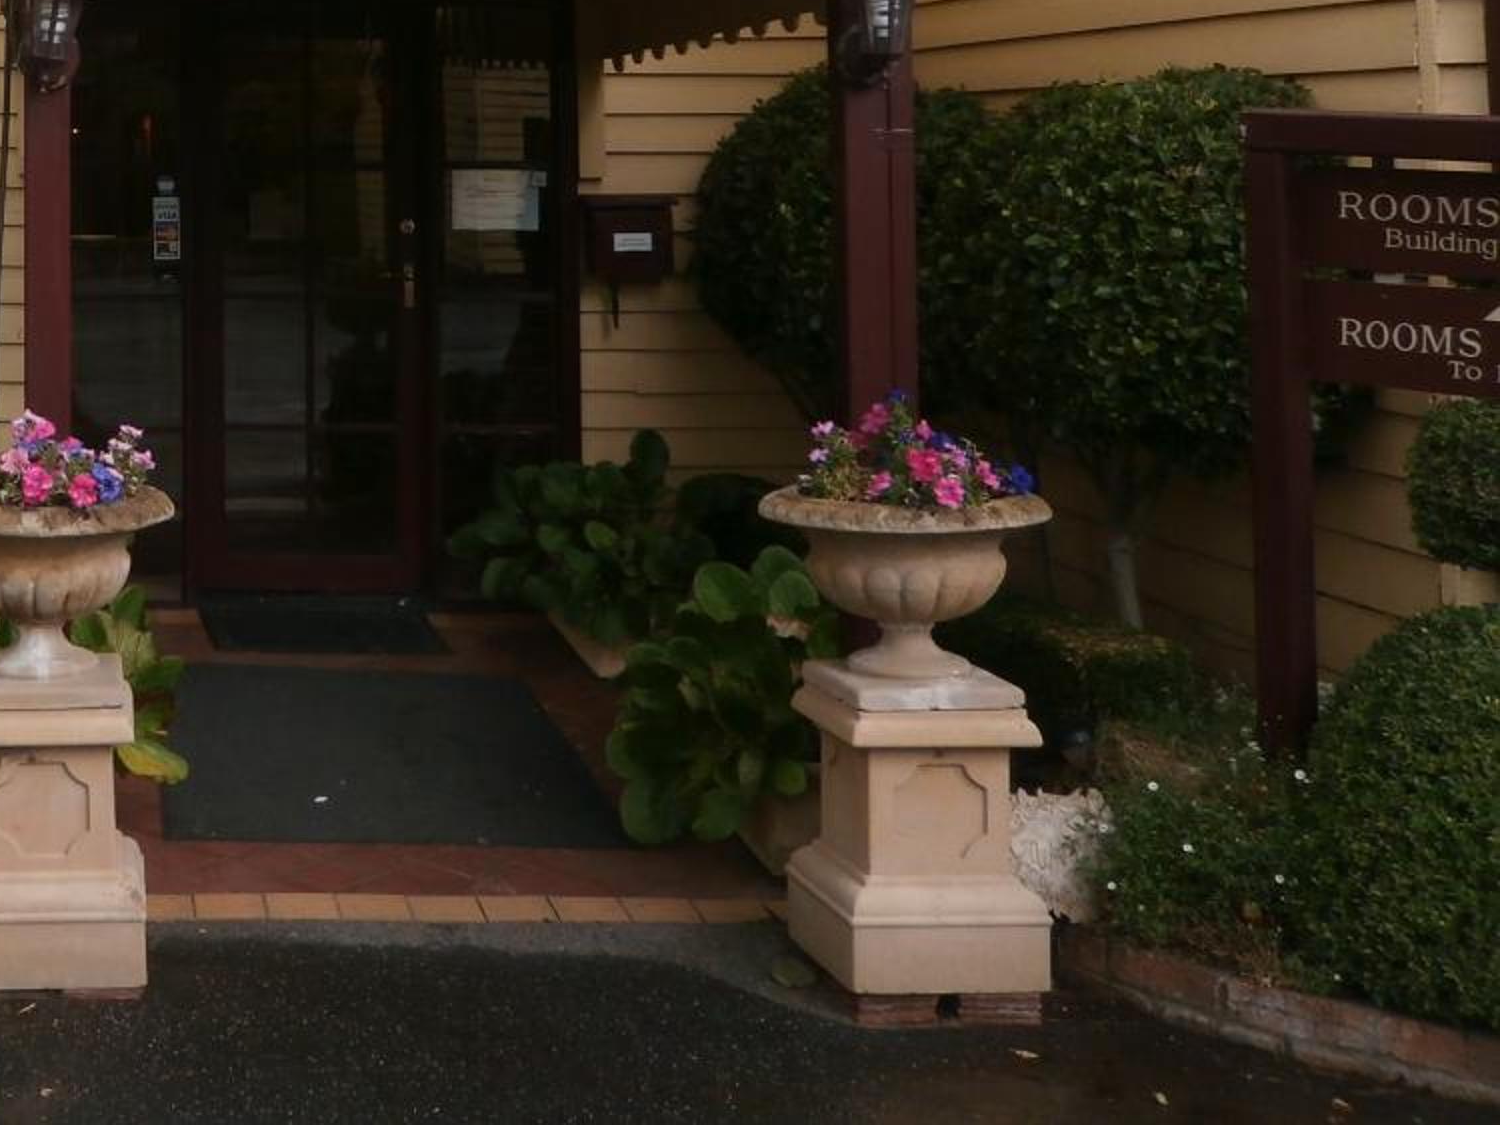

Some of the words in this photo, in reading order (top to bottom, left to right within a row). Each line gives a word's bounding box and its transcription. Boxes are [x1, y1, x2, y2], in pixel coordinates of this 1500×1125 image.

[1338, 191, 1500, 227] ROOMS
[1385, 228, 1498, 260] Building
[1340, 318, 1482, 357] ROOMS
